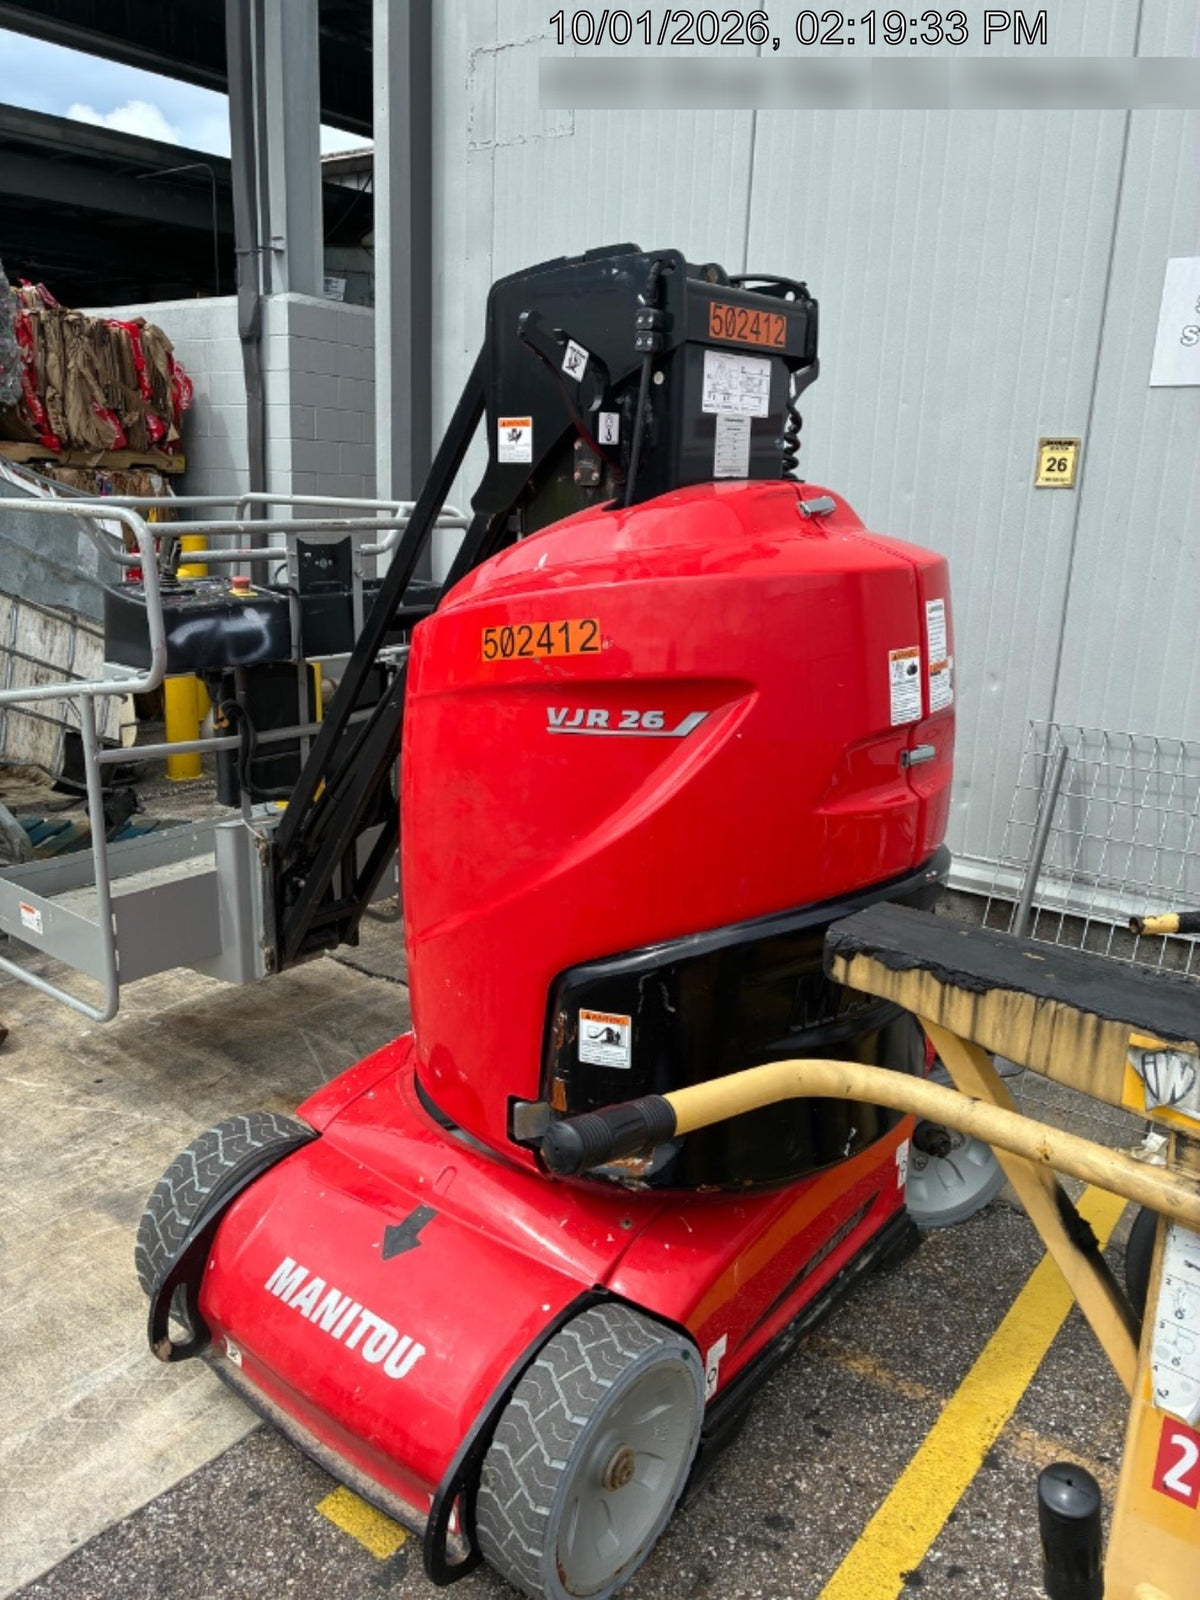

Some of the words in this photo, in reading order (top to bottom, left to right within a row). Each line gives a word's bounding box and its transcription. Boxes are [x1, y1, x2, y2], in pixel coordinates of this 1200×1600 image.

[710, 303, 785, 345] 502412
[1045, 456, 1068, 473] 26
[483, 619, 599, 660] 502412
[546, 706, 610, 729] VJR
[618, 709, 665, 729] 26
[264, 1256, 426, 1379] MANITOU
[1162, 1434, 1200, 1497] 2
